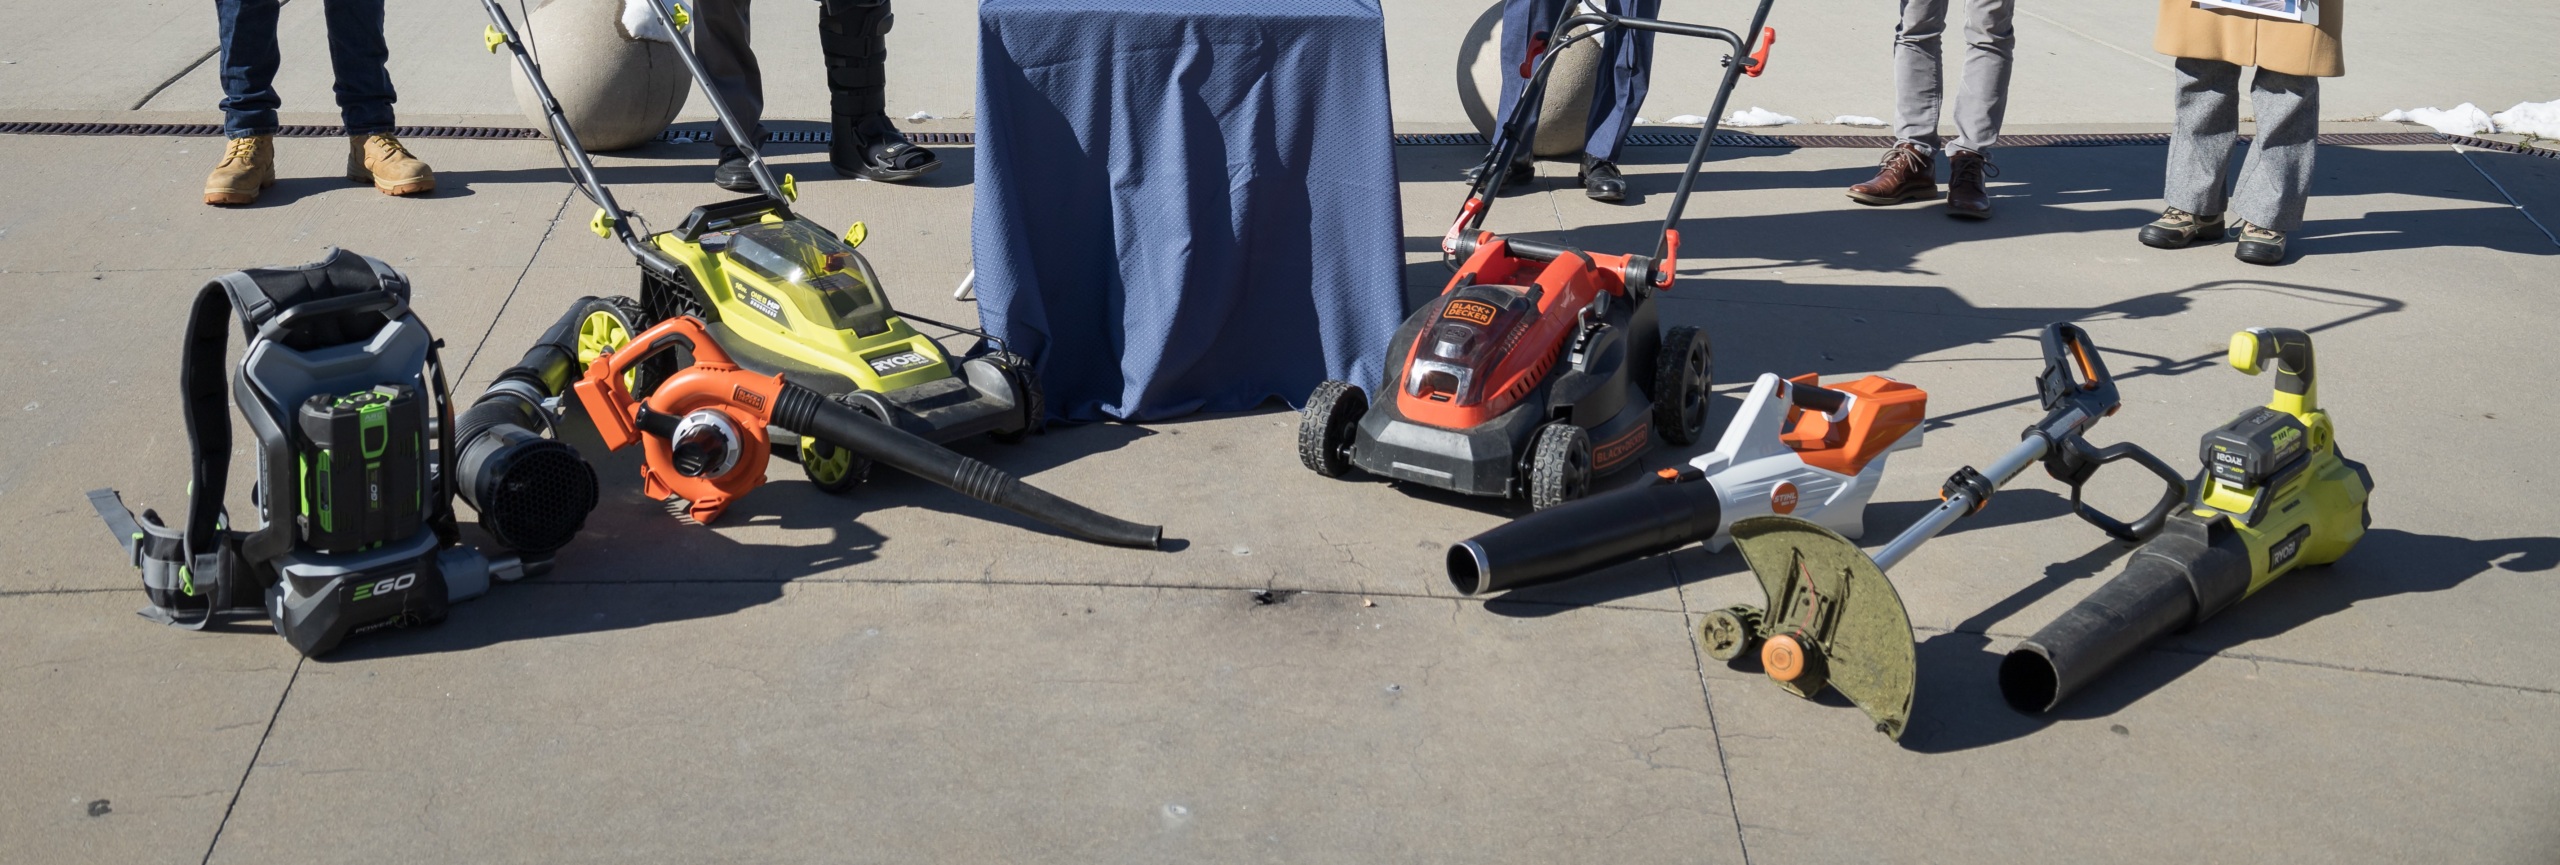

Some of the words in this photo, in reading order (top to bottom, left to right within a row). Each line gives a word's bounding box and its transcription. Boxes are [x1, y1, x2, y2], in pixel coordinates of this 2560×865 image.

[1448, 308, 1488, 321] DECKER
[1451, 302, 1490, 314] BLACK+
[871, 353, 927, 371] RYOBI
[2216, 452, 2243, 467] RYOBI
[1773, 492, 1797, 503] STIHL
[2274, 541, 2296, 565] RYOBI
[352, 573, 416, 602] EGO
